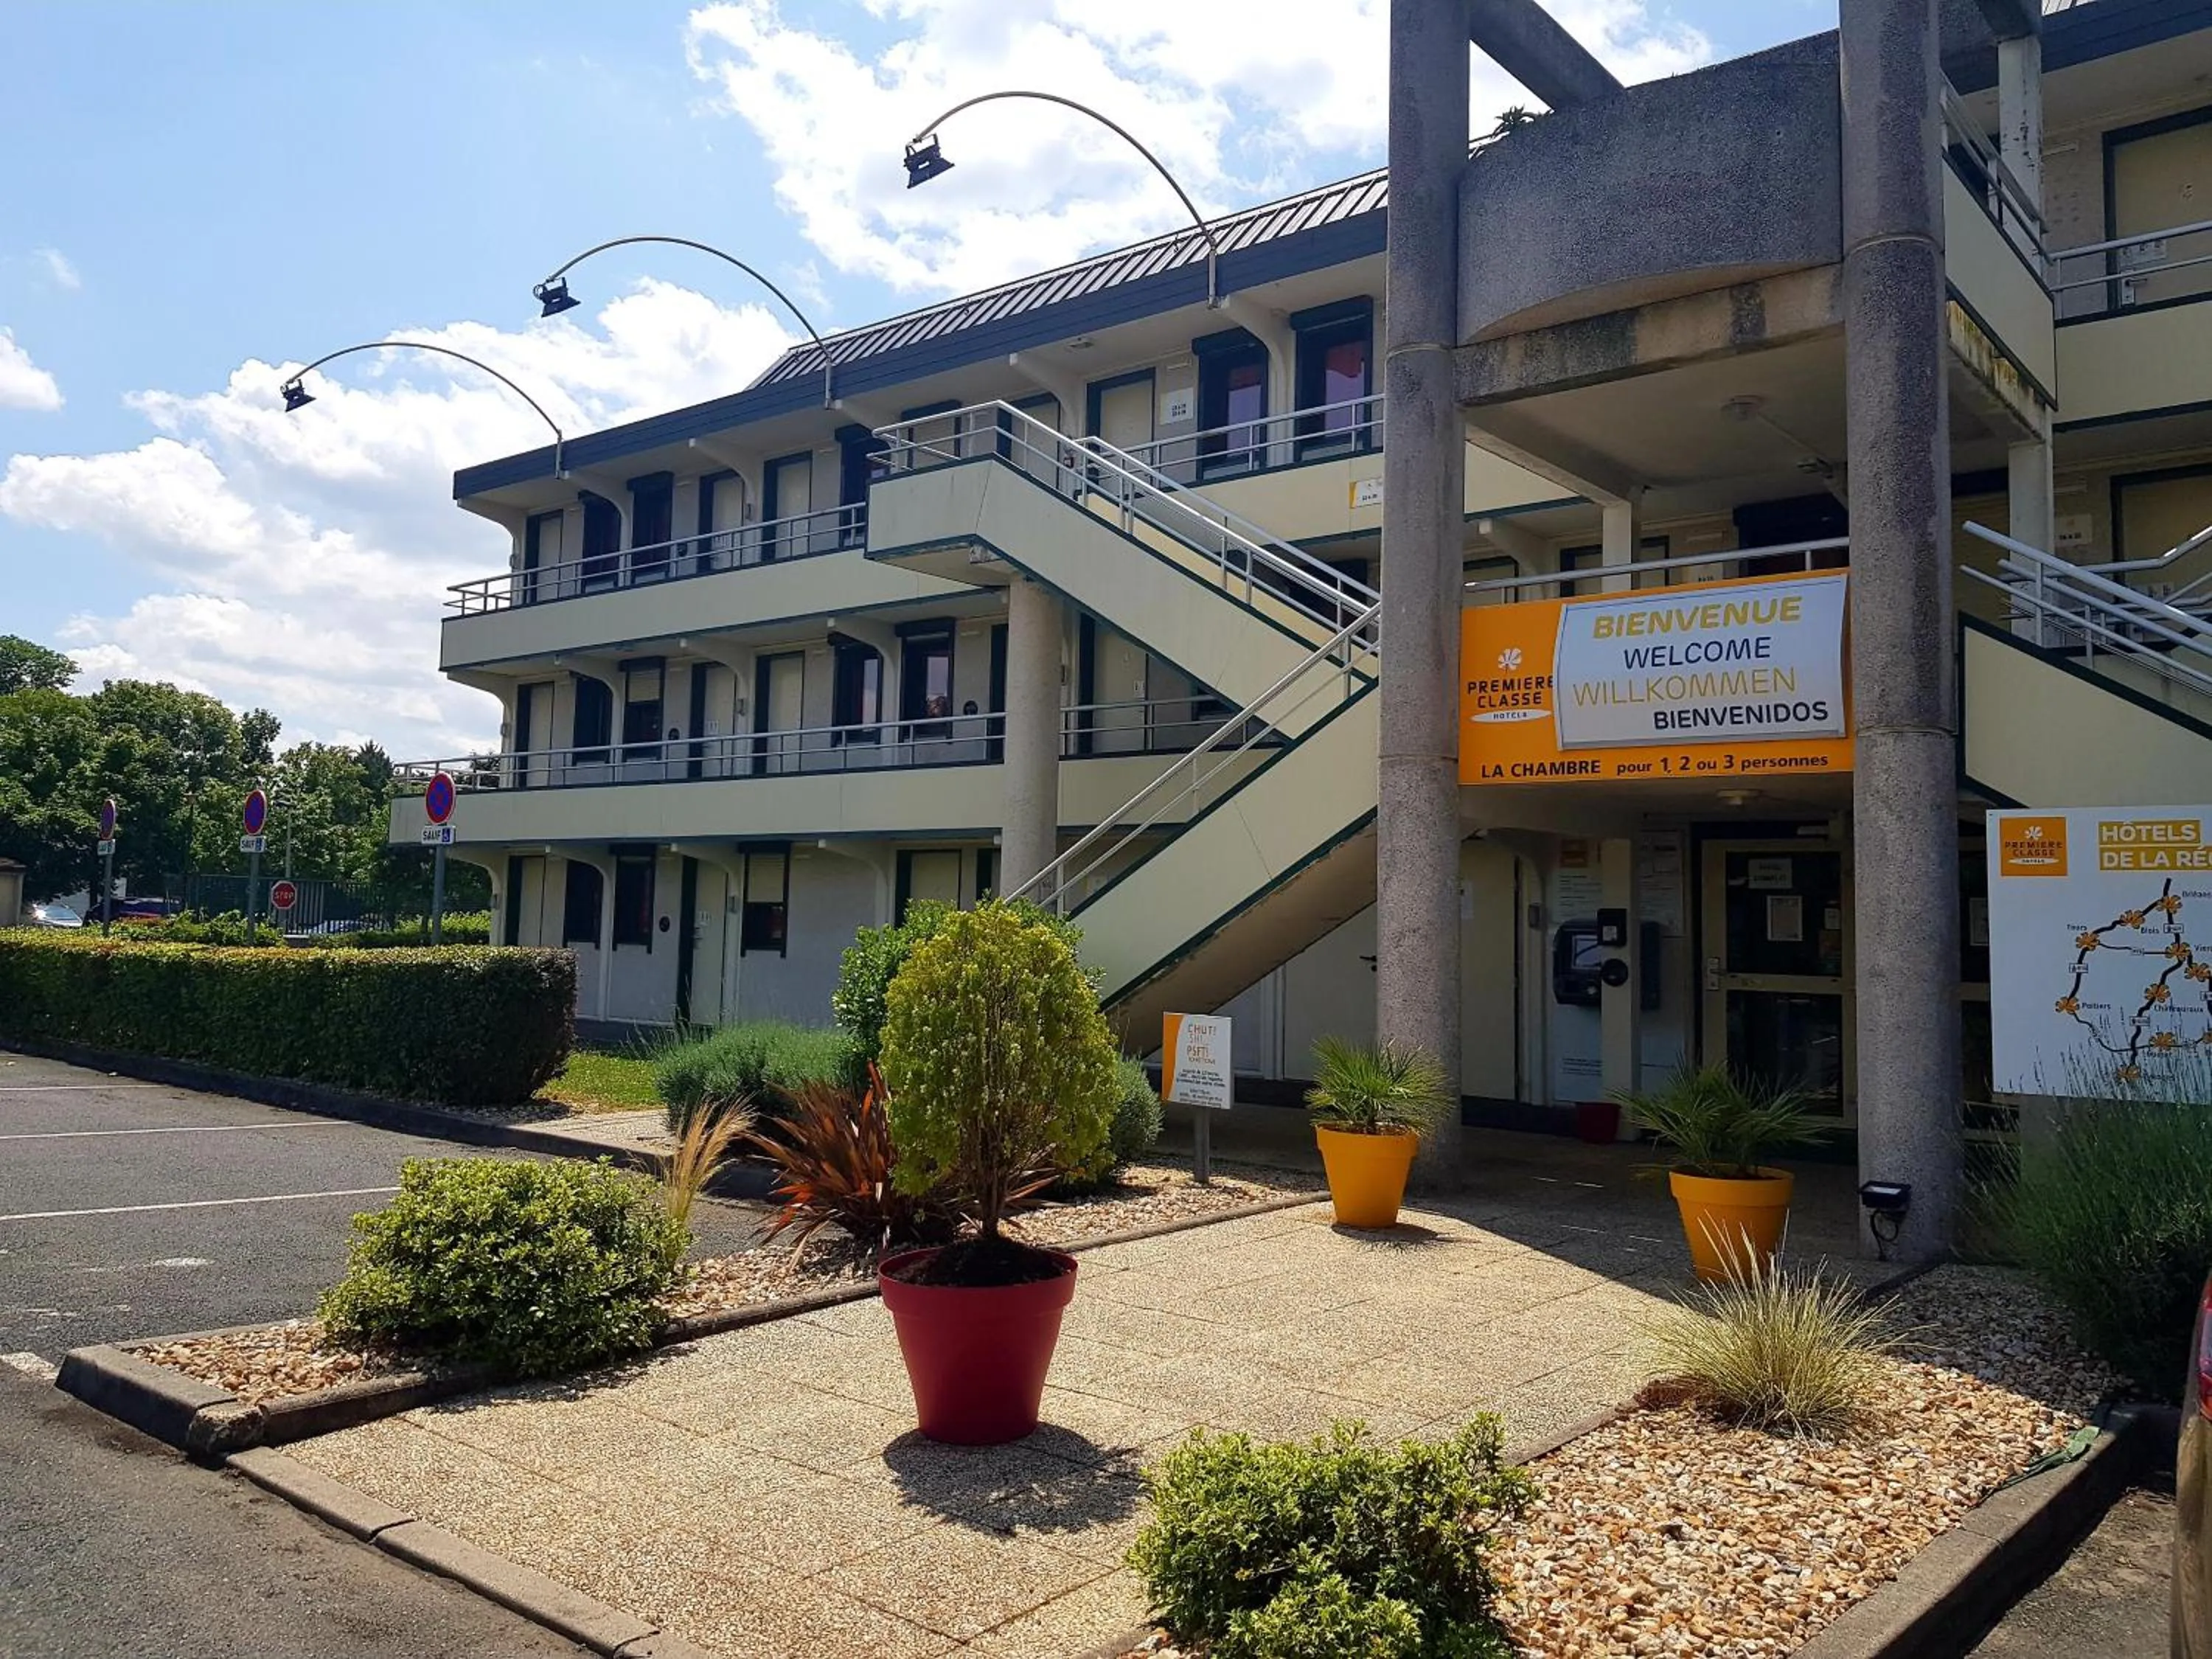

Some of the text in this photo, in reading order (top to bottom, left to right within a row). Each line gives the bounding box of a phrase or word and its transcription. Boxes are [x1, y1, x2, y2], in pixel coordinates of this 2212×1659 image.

[1593, 596, 1802, 639] BIENVENUE
[1624, 636, 1771, 669] WELCOME
[1573, 667, 1795, 706] WILLKOMMEN
[1478, 691, 1543, 709] CLASSE
[1654, 702, 1829, 730] BIENVENIDOS
[1481, 765, 1504, 778] LA
[1511, 760, 1601, 777] CHAMBRE
[1617, 762, 1652, 775] pour
[1679, 756, 1691, 771] 2
[1697, 761, 1717, 770] ou
[1723, 754, 1734, 769] 3
[1741, 755, 1829, 771] personnes
[2102, 822, 2197, 841] HÔTELS
[2104, 851, 2135, 868] DE
[2140, 850, 2171, 868] LA
[274, 891, 294, 900] STOP
